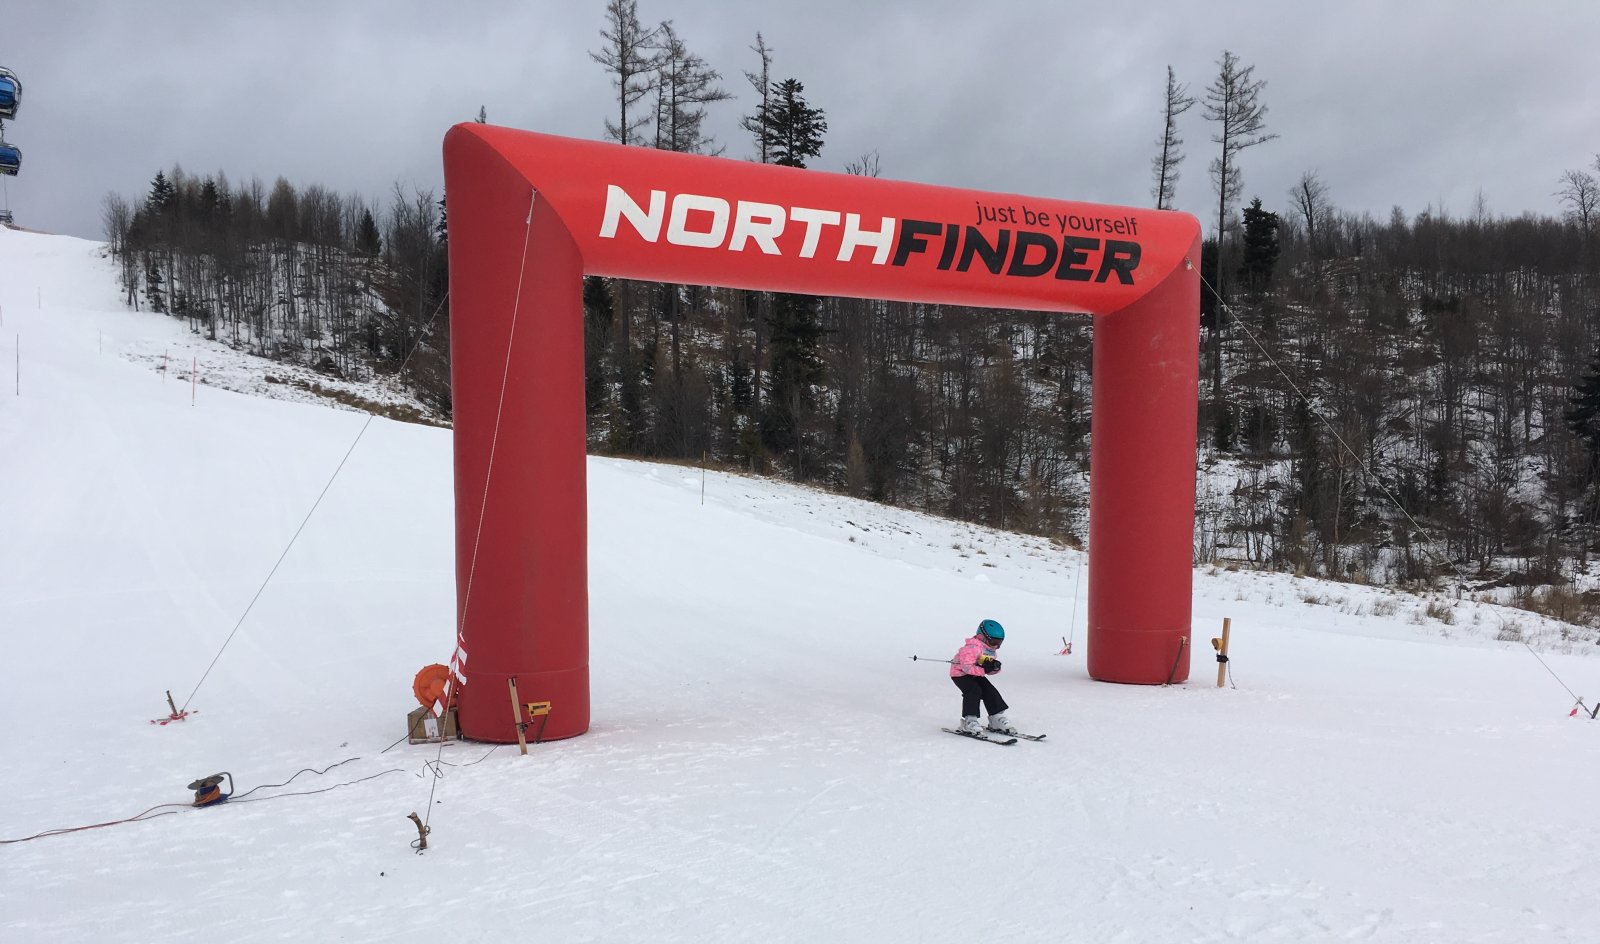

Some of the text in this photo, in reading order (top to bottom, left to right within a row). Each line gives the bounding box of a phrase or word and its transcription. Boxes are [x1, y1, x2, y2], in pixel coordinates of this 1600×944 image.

[599, 184, 1142, 285] NORTHFINDER
[976, 201, 1138, 236] just be yourself
